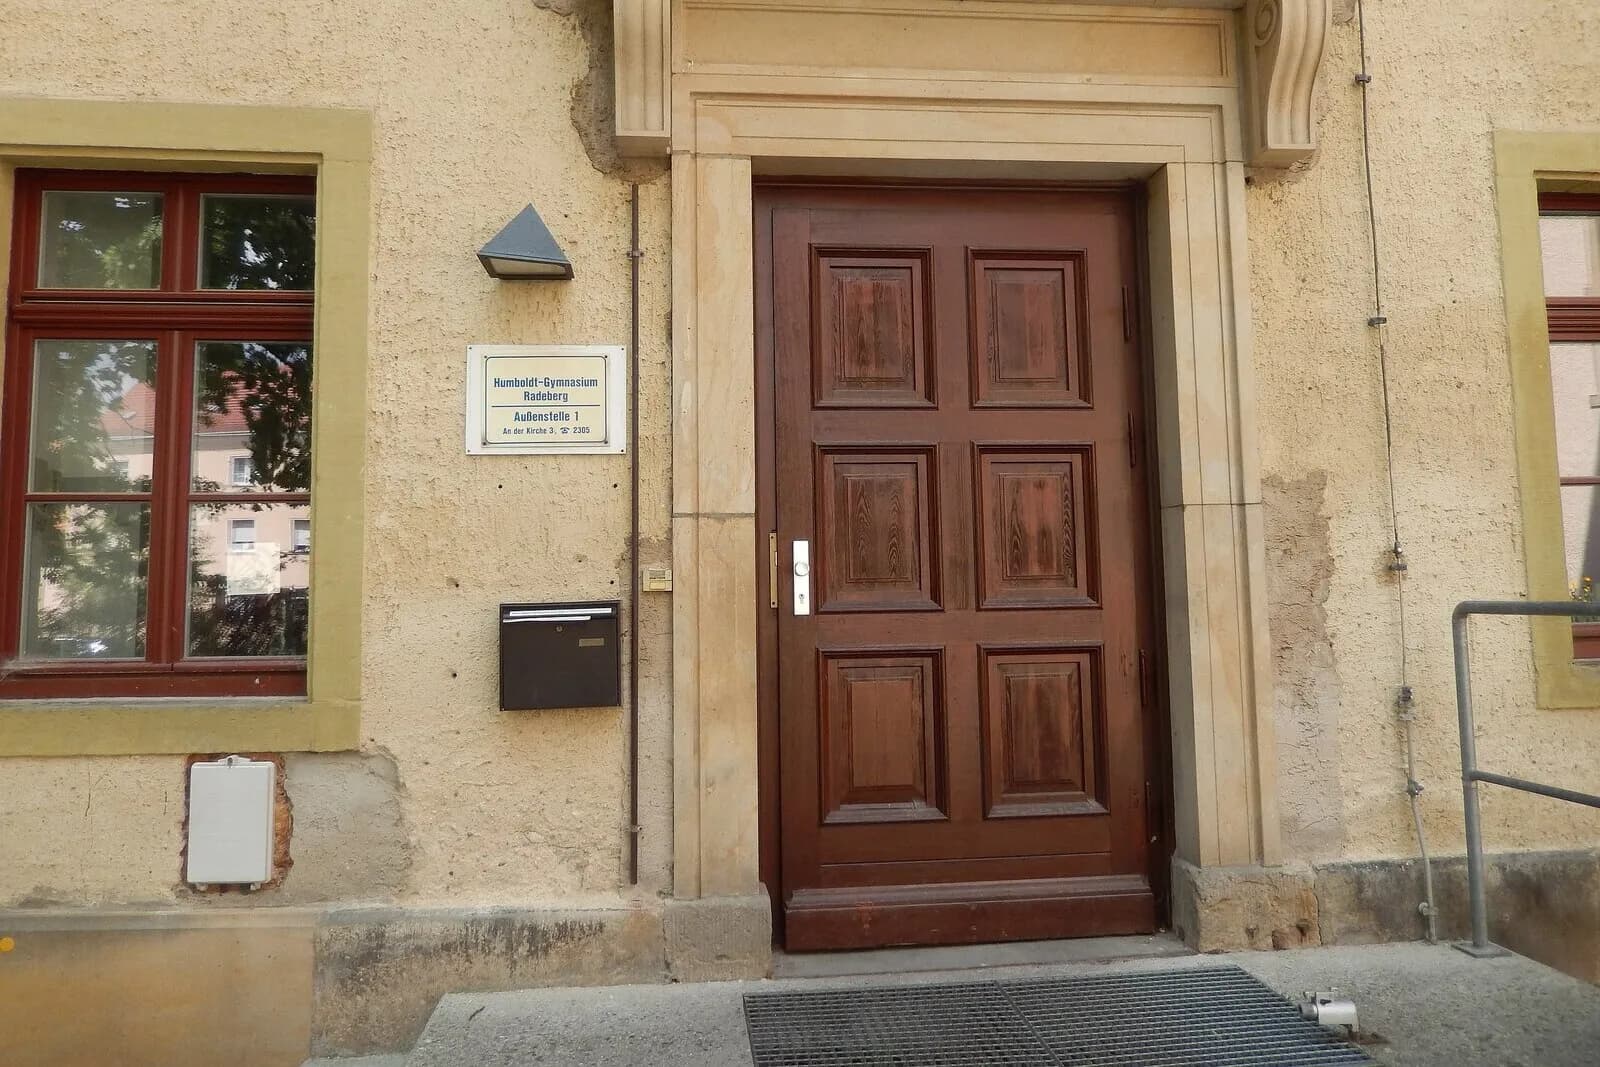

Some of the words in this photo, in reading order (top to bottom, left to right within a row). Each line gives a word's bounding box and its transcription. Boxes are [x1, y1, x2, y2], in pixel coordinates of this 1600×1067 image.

[494, 377, 598, 389] Humboldt-Gymnasium
[523, 391, 568, 402] Radeberg
[514, 411, 570, 422] Außenstelle
[574, 411, 579, 421] 1
[503, 427, 512, 435] An
[513, 427, 524, 435] der
[526, 426, 547, 435] Kirche
[573, 426, 590, 434] 2305
